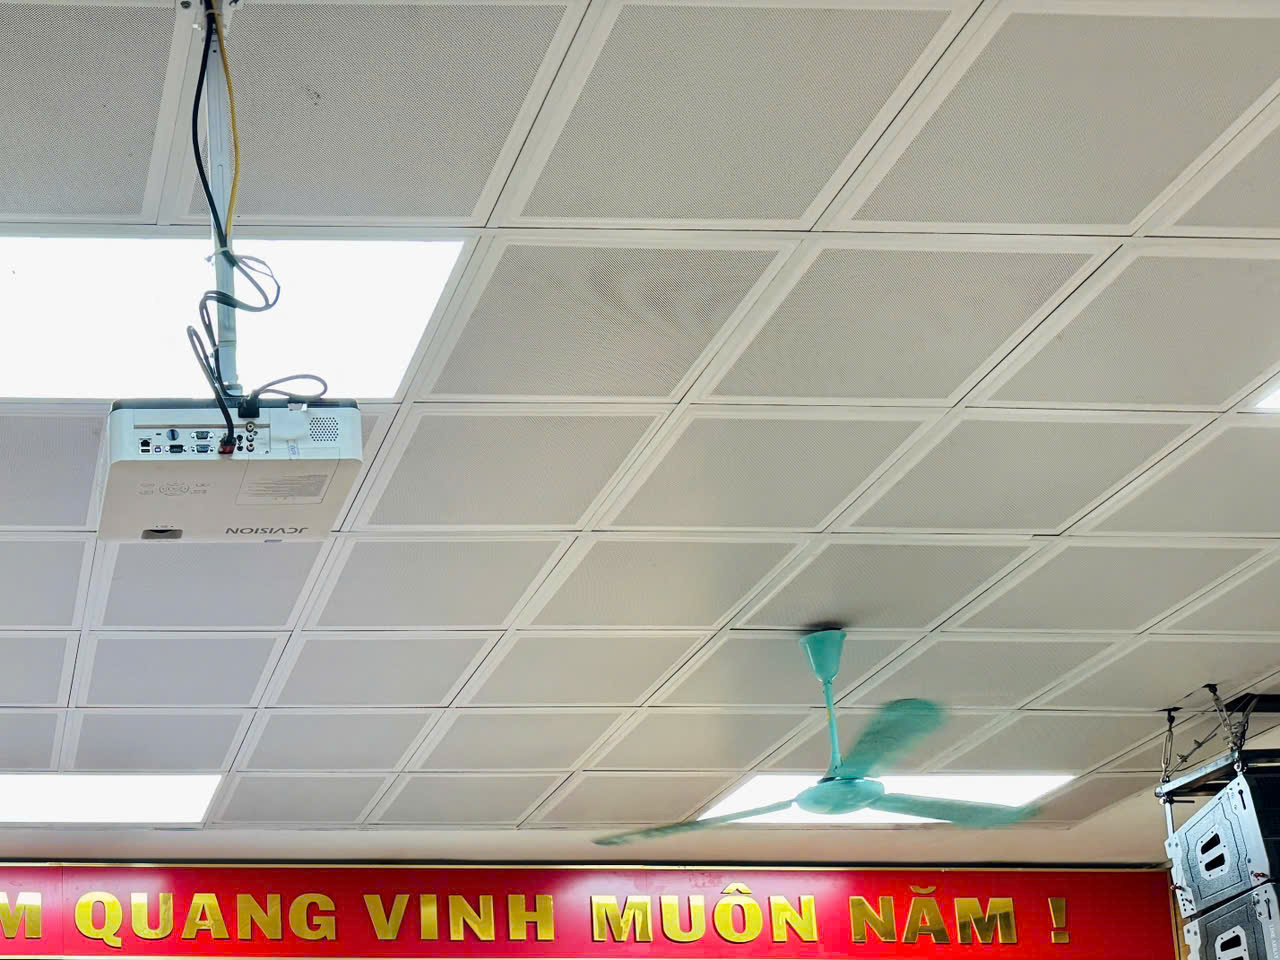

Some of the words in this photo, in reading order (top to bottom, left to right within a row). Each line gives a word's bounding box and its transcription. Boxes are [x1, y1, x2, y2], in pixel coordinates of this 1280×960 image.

[74, 891, 337, 948] QUANG
[363, 893, 555, 942] VINH
[591, 882, 818, 943] MUÔN
[848, 885, 1018, 945] NĂM
